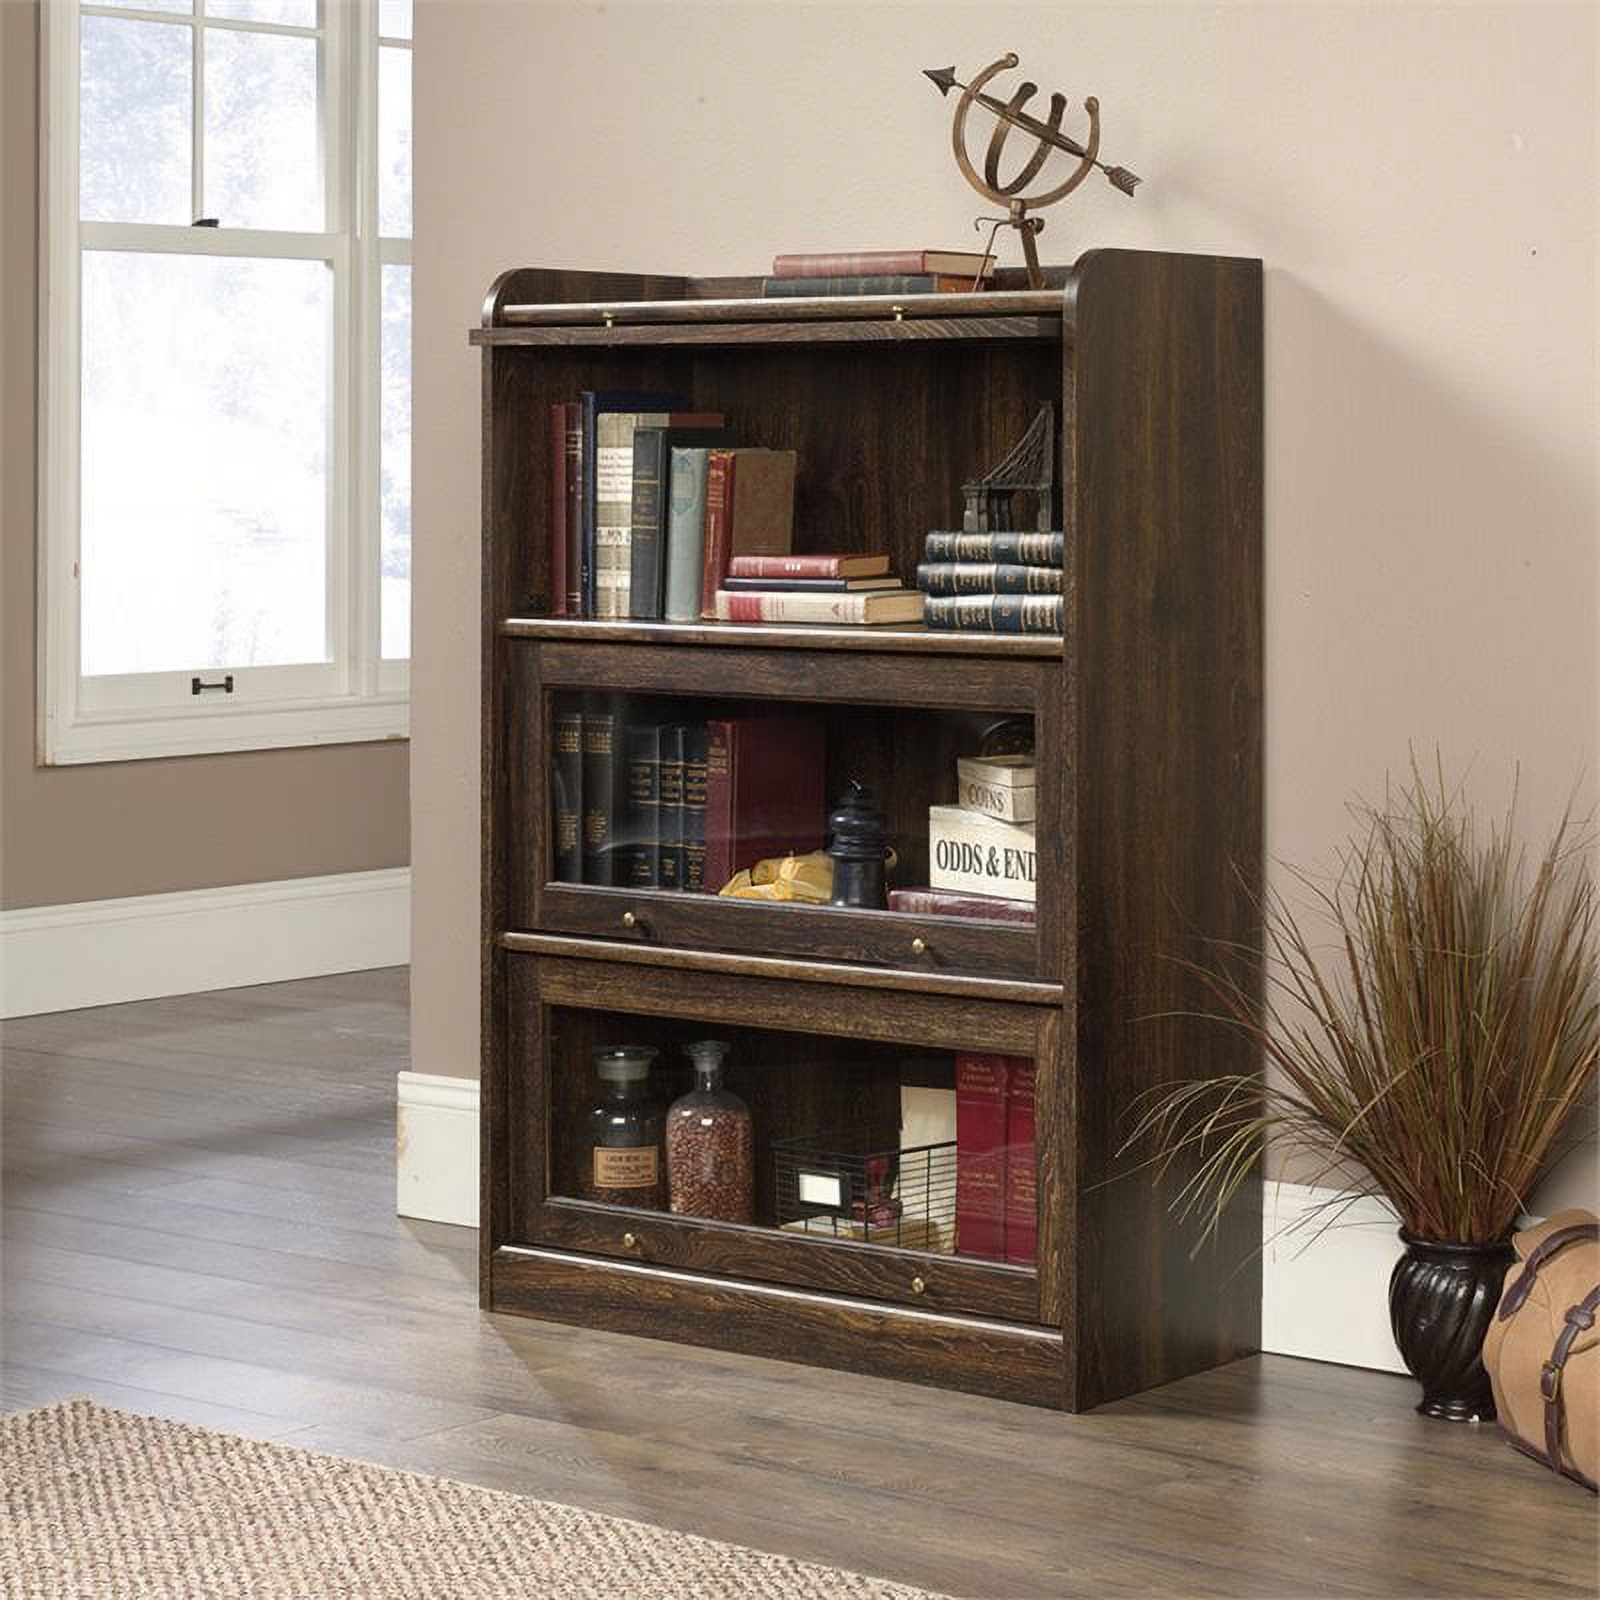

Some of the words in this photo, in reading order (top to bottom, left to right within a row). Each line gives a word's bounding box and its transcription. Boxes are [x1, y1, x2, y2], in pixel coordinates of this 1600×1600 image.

[968, 783, 1004, 812] COINS
[936, 839, 982, 875] ODDS
[986, 846, 999, 877] &
